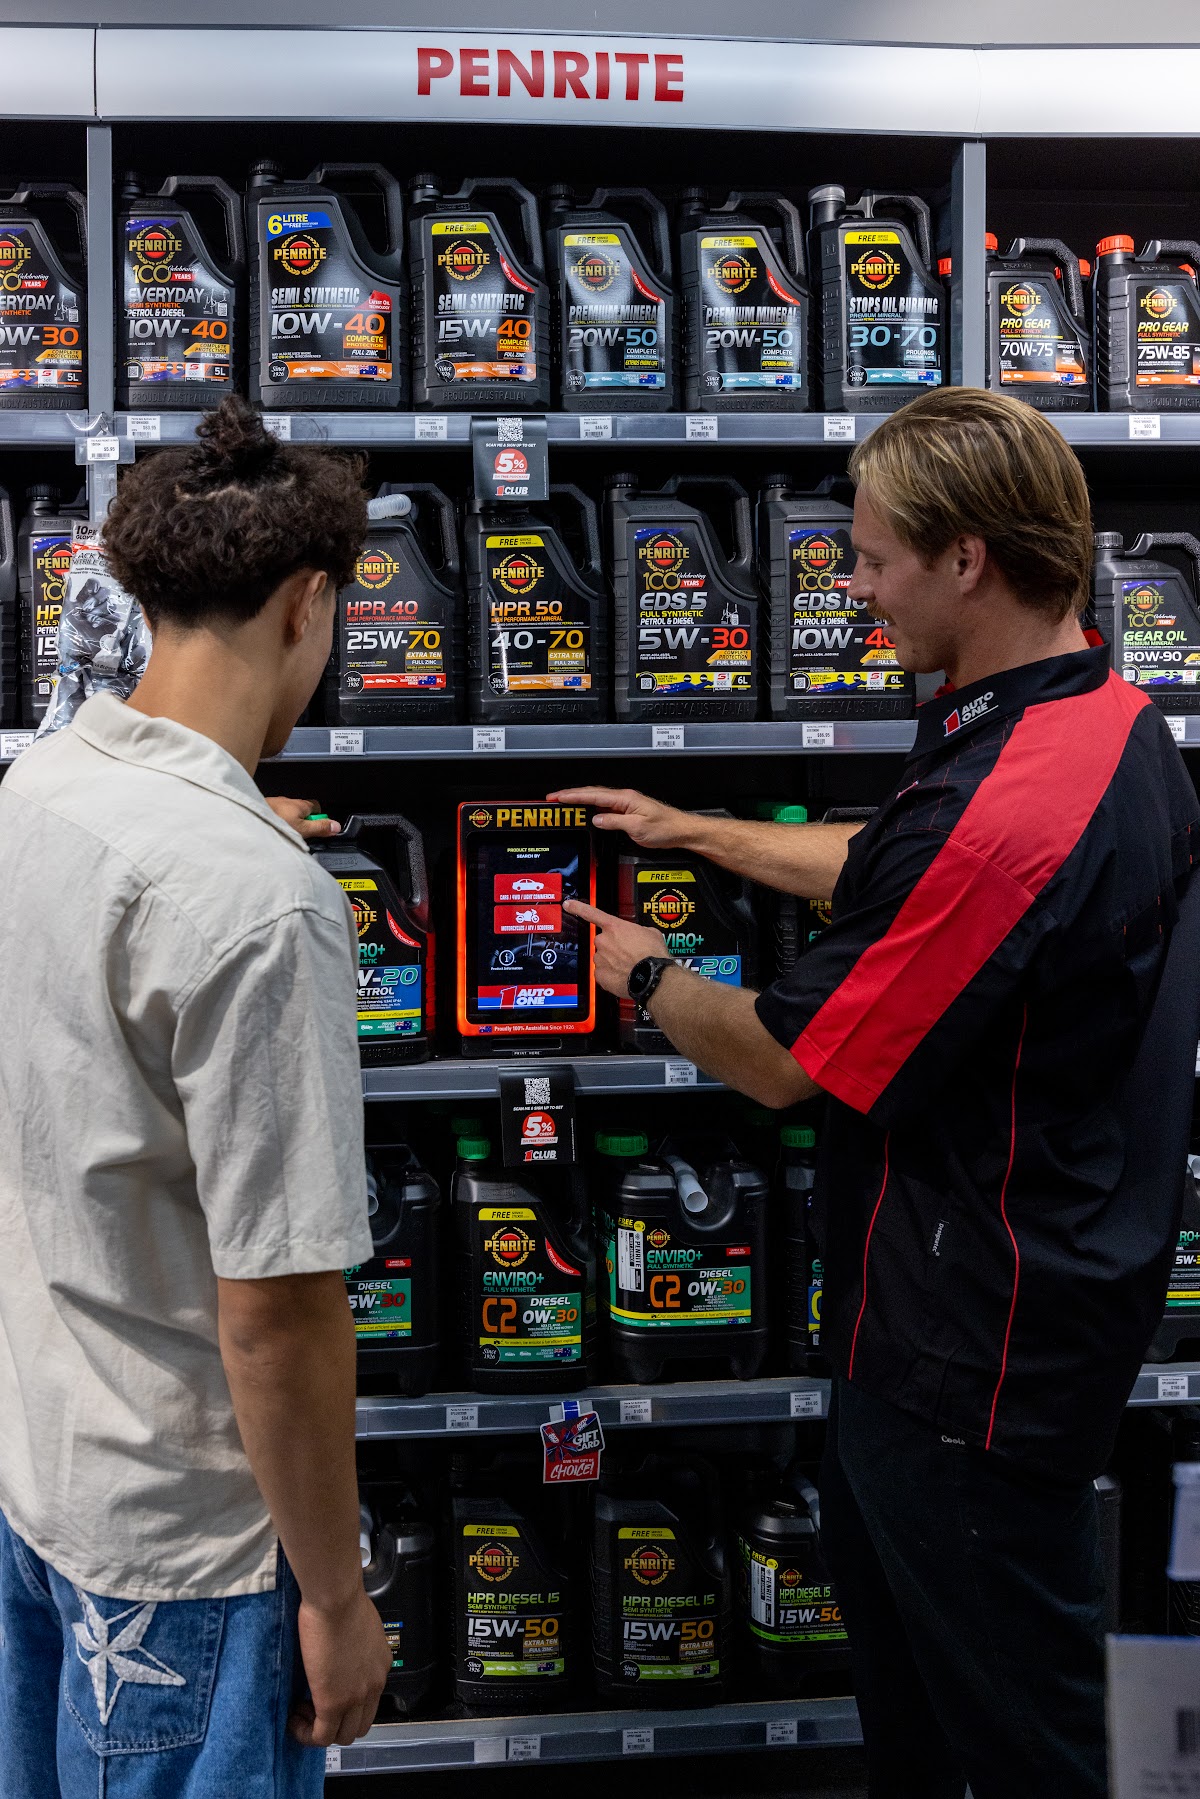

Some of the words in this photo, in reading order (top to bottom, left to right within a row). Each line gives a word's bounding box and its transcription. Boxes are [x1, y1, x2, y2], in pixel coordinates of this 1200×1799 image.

[417, 47, 684, 102] PENRITE
[267, 214, 283, 235] 6
[283, 213, 309, 222] LITRE
[129, 240, 182, 251] PENRITE
[274, 248, 327, 260] PENRITE
[437, 253, 490, 266] PENRITE
[132, 265, 171, 283] 100
[570, 265, 621, 277] PENRITE
[707, 267, 758, 279] PENRITE
[851, 264, 901, 275] PENRITE
[129, 287, 204, 303] EVERYDAY
[272, 287, 300, 304] SEMI
[303, 286, 360, 304] SYNTHETIC
[438, 293, 467, 311] SEMI
[470, 293, 525, 311] SYNTHETIC
[1000, 294, 1042, 305] PENRITE
[849, 297, 881, 313] STOPS
[881, 297, 898, 313] OIL
[898, 297, 939, 315] BURNING
[1140, 298, 1178, 308] PENRITE
[127, 309, 153, 317] PETROL
[155, 309, 160, 317] &
[164, 309, 185, 317] DIESEL
[705, 306, 756, 323] PREMIUM
[756, 306, 798, 323] MINERAL
[129, 319, 228, 339] 10W-40
[271, 312, 385, 335] 10W-40
[438, 319, 532, 339] 15W-40
[1000, 318, 1022, 329] PRO
[1024, 318, 1051, 329] GEAR
[1137, 322, 1160, 332] PRO
[1162, 322, 1190, 332] GEAR
[568, 328, 658, 347] 20W-50
[705, 329, 794, 348] 20W-50
[849, 325, 937, 348] 30-70
[1000, 342, 1054, 357] 70W-75
[1137, 345, 1190, 360] 75W-85
[67, 373, 79, 381] 5L
[215, 367, 226, 376] 5L
[497, 453, 524, 473] 5%
[499, 538, 518, 546] FREE
[638, 547, 690, 560] PENRITE
[792, 548, 844, 560] PENRITE
[492, 566, 545, 579] PENRITE
[643, 572, 681, 591] 100
[797, 572, 835, 591] 100
[639, 592, 687, 611] EDS
[691, 592, 708, 610] 5
[793, 592, 842, 611] EDS
[1124, 596, 1164, 605] PENRITE
[346, 601, 386, 616] HPR
[390, 600, 419, 616] 40
[491, 602, 530, 617] HPR
[535, 600, 563, 616] 50
[815, 610, 858, 618] SYNTHETIC
[672, 617, 694, 625] DIESEL
[826, 617, 848, 625] DIESEL
[1128, 613, 1157, 628] 100
[347, 630, 441, 650] 25W-70
[491, 630, 584, 650] 40-70
[638, 628, 748, 650] 5W-30
[1123, 630, 1164, 641] GEAR
[1166, 630, 1188, 641] OIL
[1123, 651, 1182, 662] 80W-90
[737, 675, 748, 685] 6L
[890, 675, 901, 684] 6L
[961, 691, 994, 715] AUTO
[961, 702, 989, 722] ONE
[496, 807, 587, 827] PENRITE
[650, 873, 670, 881] FREE
[643, 901, 696, 914] PENRITE
[517, 988, 555, 997] AUTO
[516, 996, 546, 1005] ONE
[524, 1116, 552, 1137] 5%
[491, 1211, 511, 1219] FREE
[484, 1239, 536, 1252] PENRITE
[647, 1248, 704, 1264] ENVIRO+
[483, 1271, 545, 1287] ENVIRO+
[699, 1270, 734, 1279] DIESEL
[357, 1281, 393, 1291] DIESEL
[650, 1275, 681, 1308] C2
[687, 1279, 745, 1297] 0W-30
[530, 1297, 571, 1307] DIESEL
[482, 1297, 518, 1334] C2
[522, 1309, 578, 1325] 0W-30
[572, 1429, 598, 1446] GIFT
[550, 1463, 594, 1479] CHOICE!
[476, 1527, 495, 1535] FREE
[631, 1530, 650, 1538] FREE
[468, 1555, 520, 1568] PENRITE
[624, 1557, 676, 1571] PENRITE
[467, 1592, 495, 1604] HPR
[498, 1593, 544, 1604] DIESEL
[548, 1592, 560, 1603] 15
[779, 1588, 796, 1600] HPR
[796, 1587, 822, 1599] DIESEL
[823, 1586, 831, 1597] 15
[623, 1595, 651, 1607] HPR
[654, 1595, 700, 1608] DIESEL
[703, 1594, 715, 1606] 15
[467, 1617, 559, 1638] 15W-50
[623, 1619, 714, 1641] 15W-50
